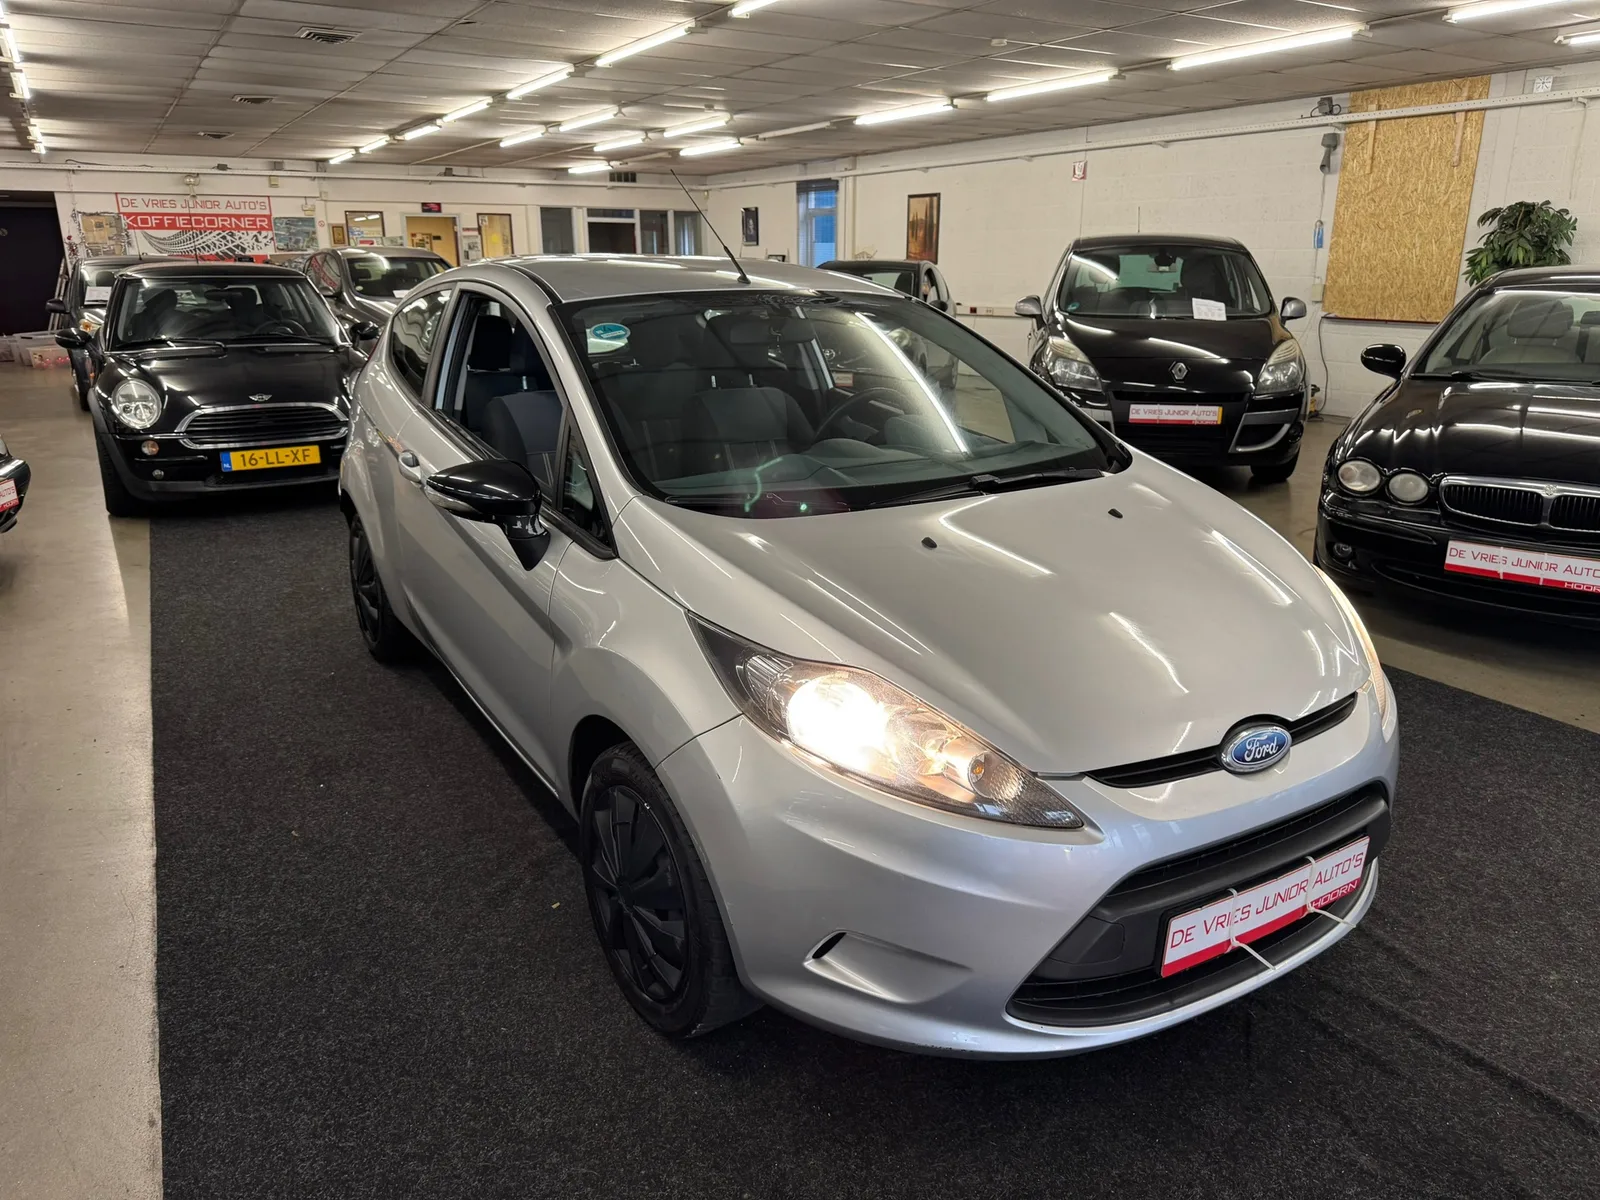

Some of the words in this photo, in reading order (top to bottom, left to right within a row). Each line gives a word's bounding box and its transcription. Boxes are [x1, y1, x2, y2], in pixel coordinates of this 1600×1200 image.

[120, 198, 138, 208] DE
[142, 198, 177, 209] VRIES
[180, 199, 221, 210] JUNIOR
[225, 200, 267, 210] AUTO'S
[123, 215, 269, 229] KOFFIECORNER
[240, 448, 310, 467] 16-LL-XF
[1449, 547, 1467, 559] DE
[1471, 550, 1508, 565] VRIES
[1511, 557, 1559, 572] JUNIOR
[1244, 734, 1279, 762] Ford
[1170, 925, 1196, 949] DE
[1203, 904, 1252, 935] VRIES
[1255, 879, 1309, 916] JUNIOR
[1312, 852, 1364, 890] AUTO'S
[1312, 880, 1358, 909] HOORN
